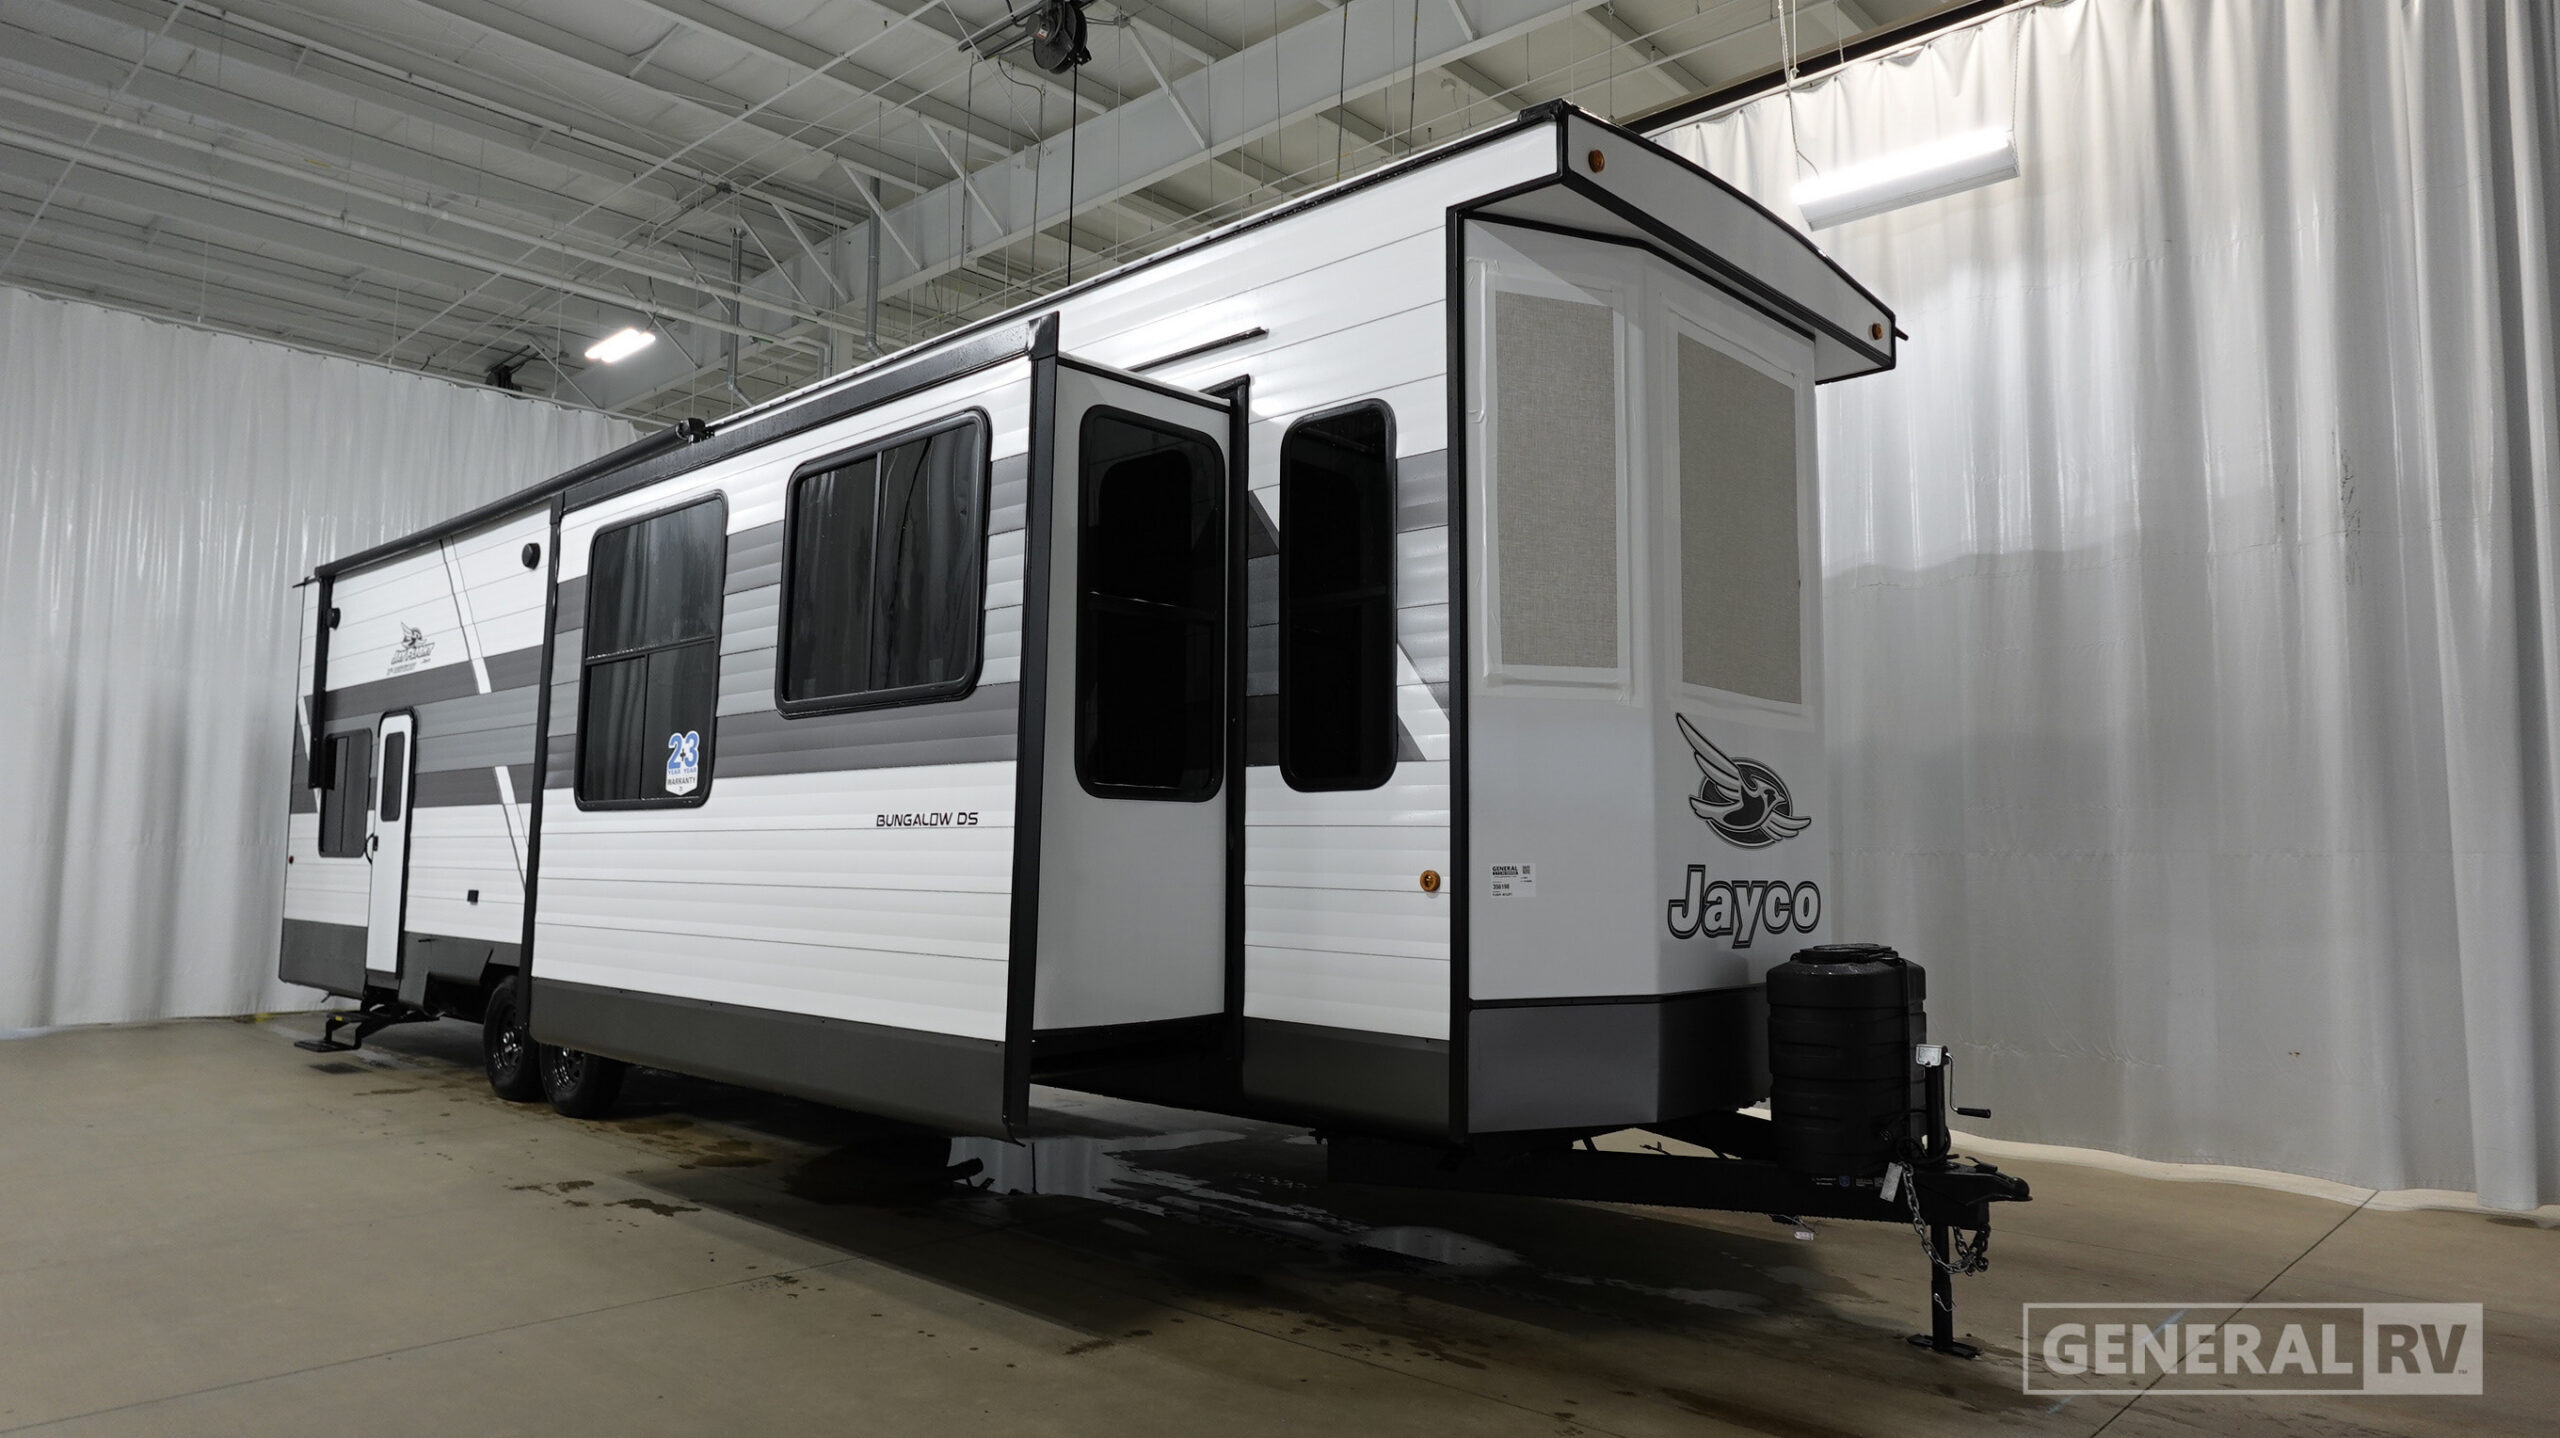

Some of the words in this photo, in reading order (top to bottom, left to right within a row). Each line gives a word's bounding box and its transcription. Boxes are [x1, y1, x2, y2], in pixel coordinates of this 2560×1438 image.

[667, 777, 696, 785] WARRANTY
[876, 812, 953, 826] BUNGALOW
[957, 812, 978, 825] DS
[1667, 864, 1821, 949] Jayco
